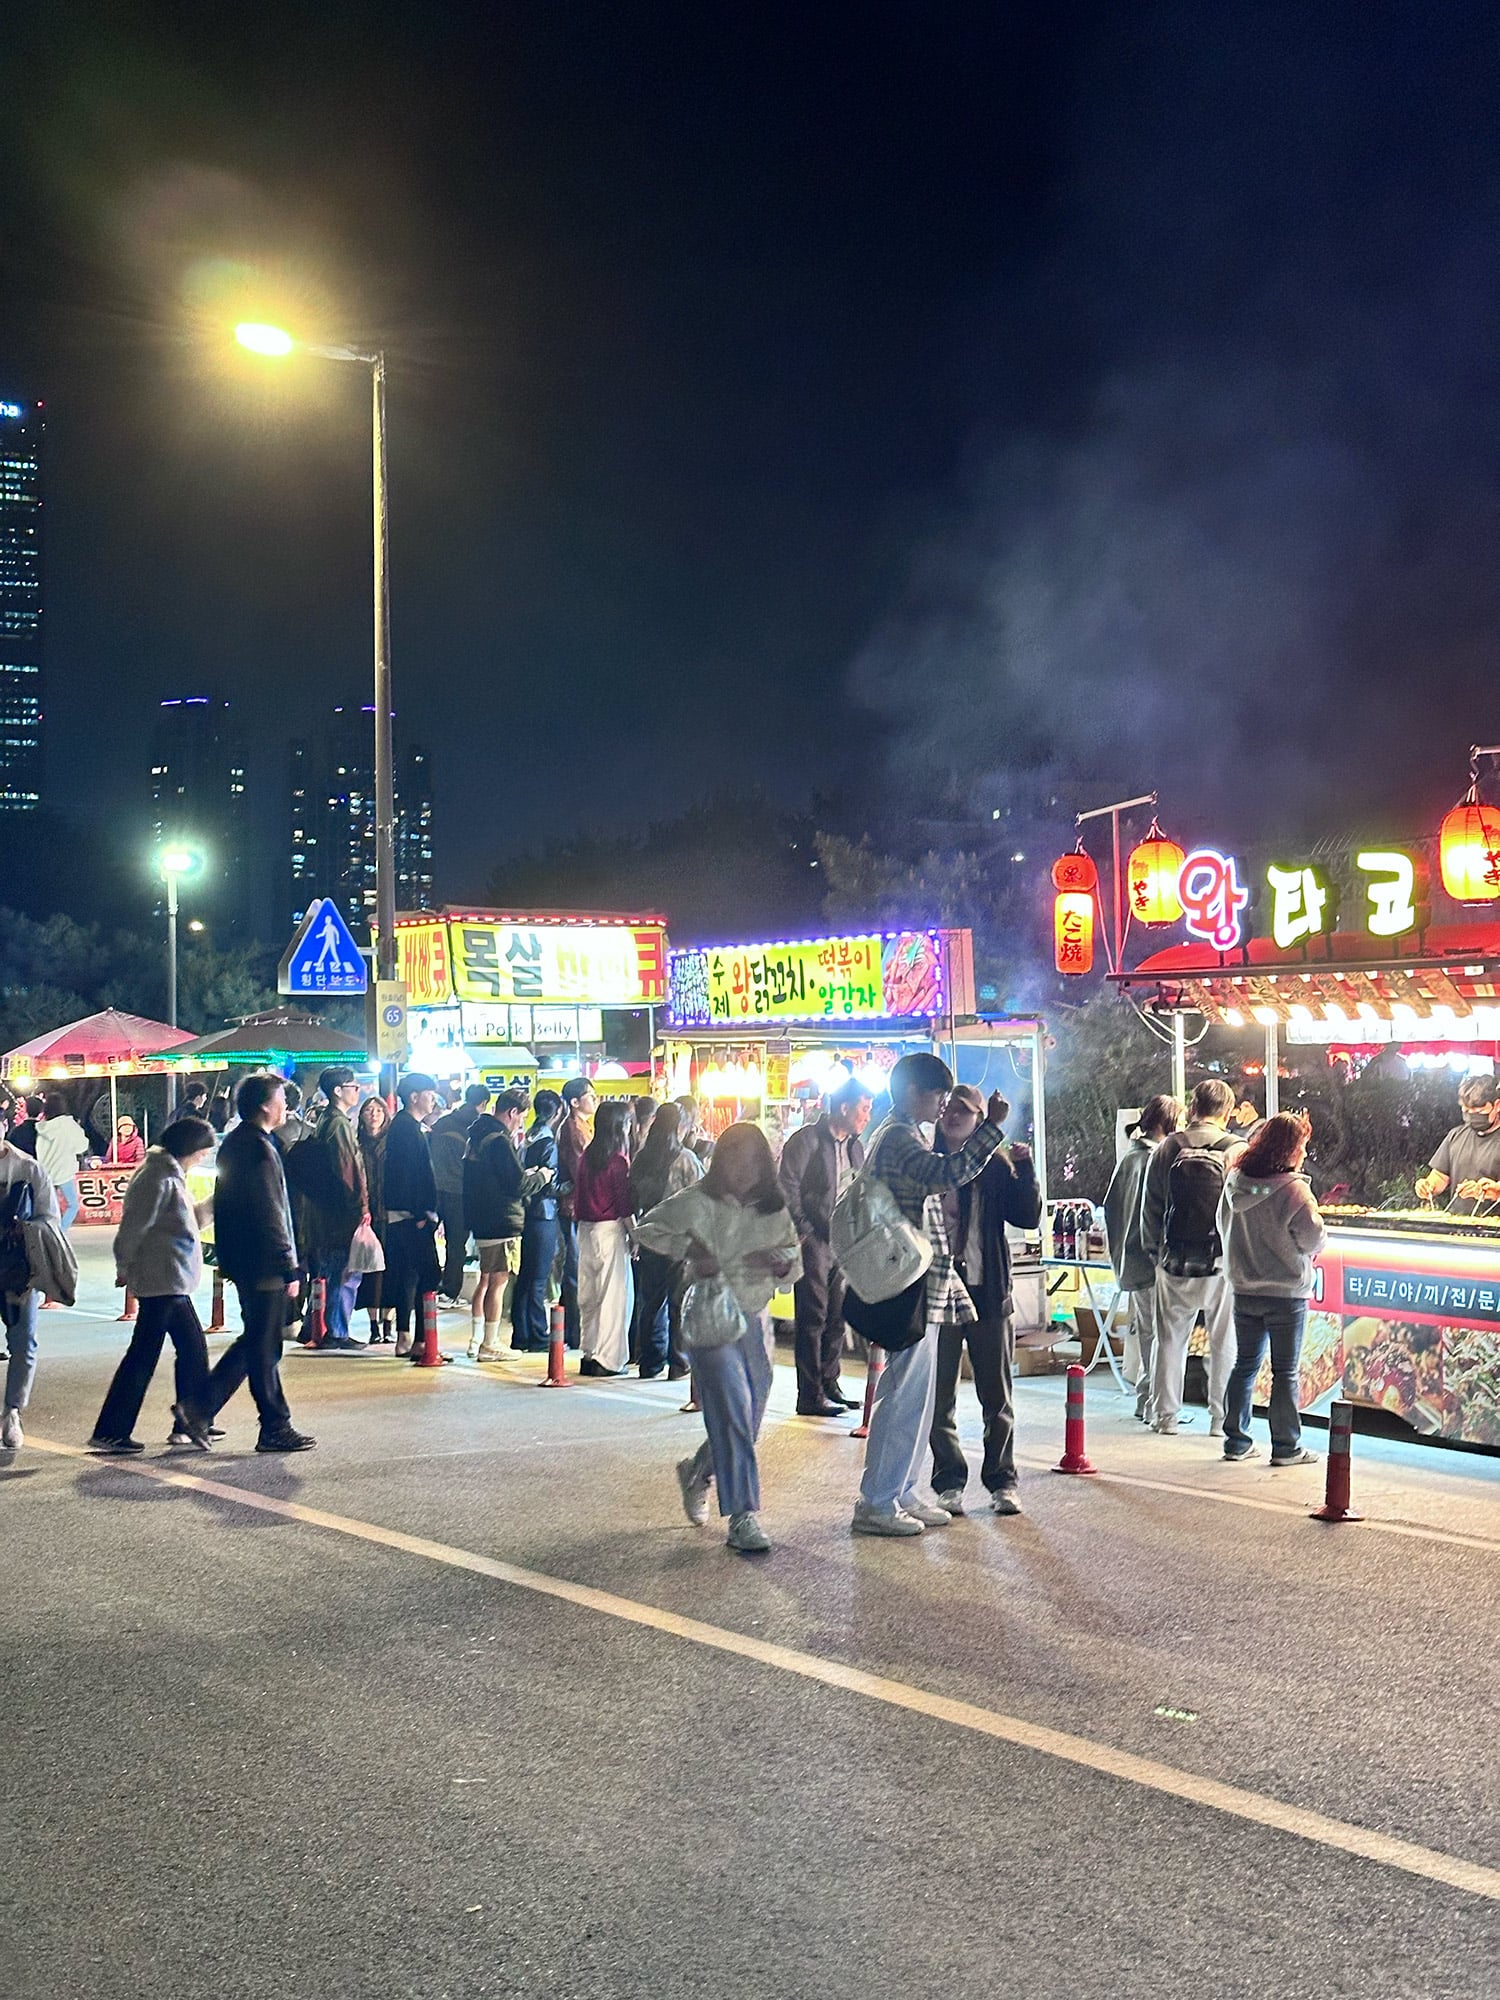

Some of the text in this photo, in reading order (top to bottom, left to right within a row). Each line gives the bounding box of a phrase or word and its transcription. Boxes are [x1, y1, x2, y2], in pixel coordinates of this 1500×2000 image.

[1060, 910, 1082, 962] たこ焼
[462, 929, 543, 998] 목살
[818, 942, 871, 979] 떡볶이
[301, 973, 356, 987] 횡단보도
[386, 1009, 400, 1023] 65
[818, 982, 877, 1015] 알감자
